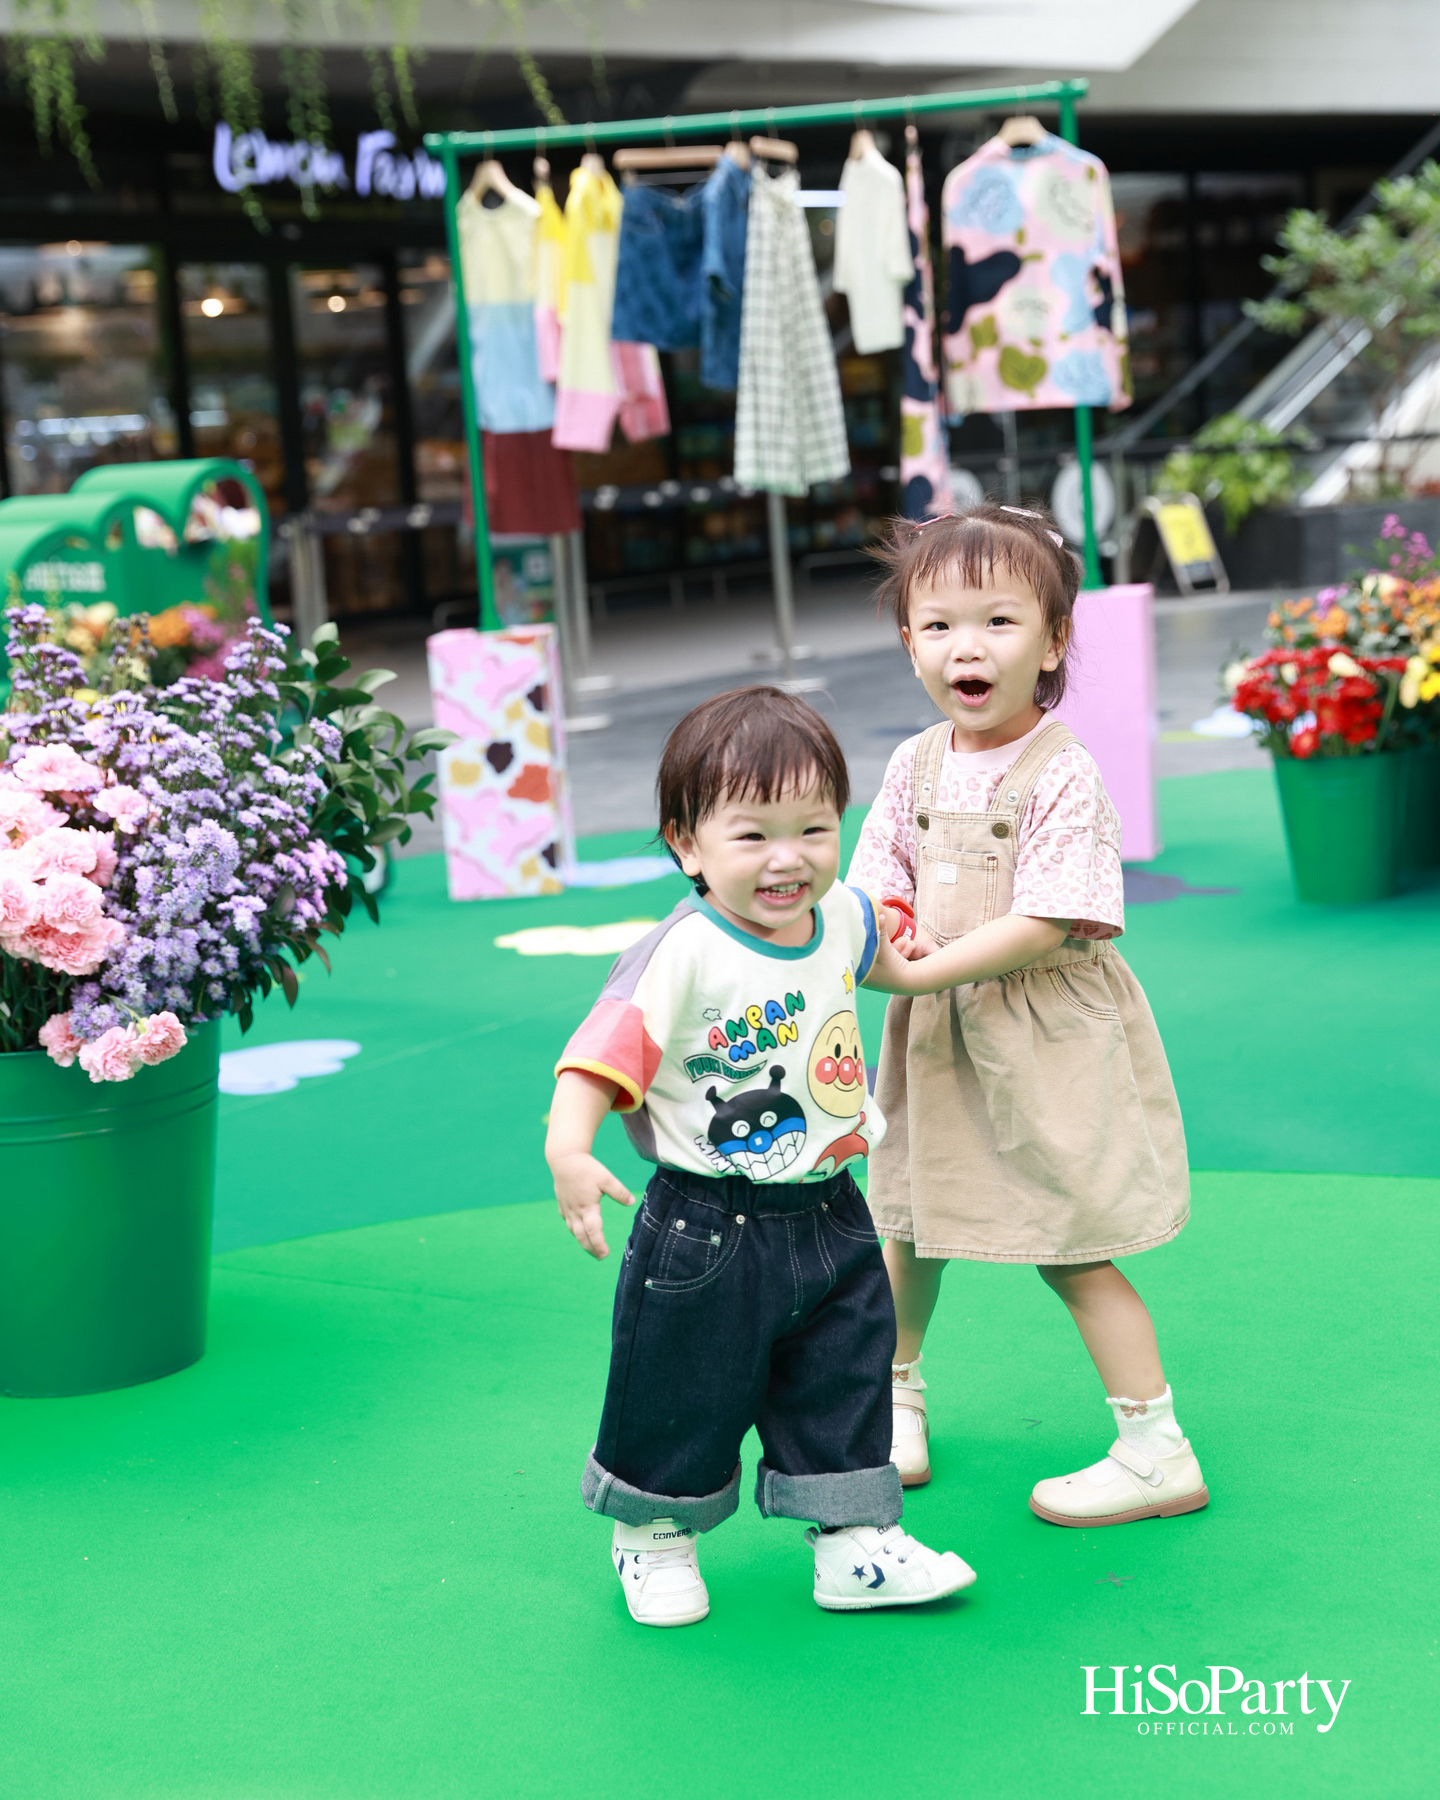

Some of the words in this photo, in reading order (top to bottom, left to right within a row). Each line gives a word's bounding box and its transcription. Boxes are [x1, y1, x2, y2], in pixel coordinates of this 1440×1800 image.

[708, 990, 806, 1051] ANPAN
[728, 1021, 799, 1062] MAN
[685, 1056, 721, 1079] YUUKI
